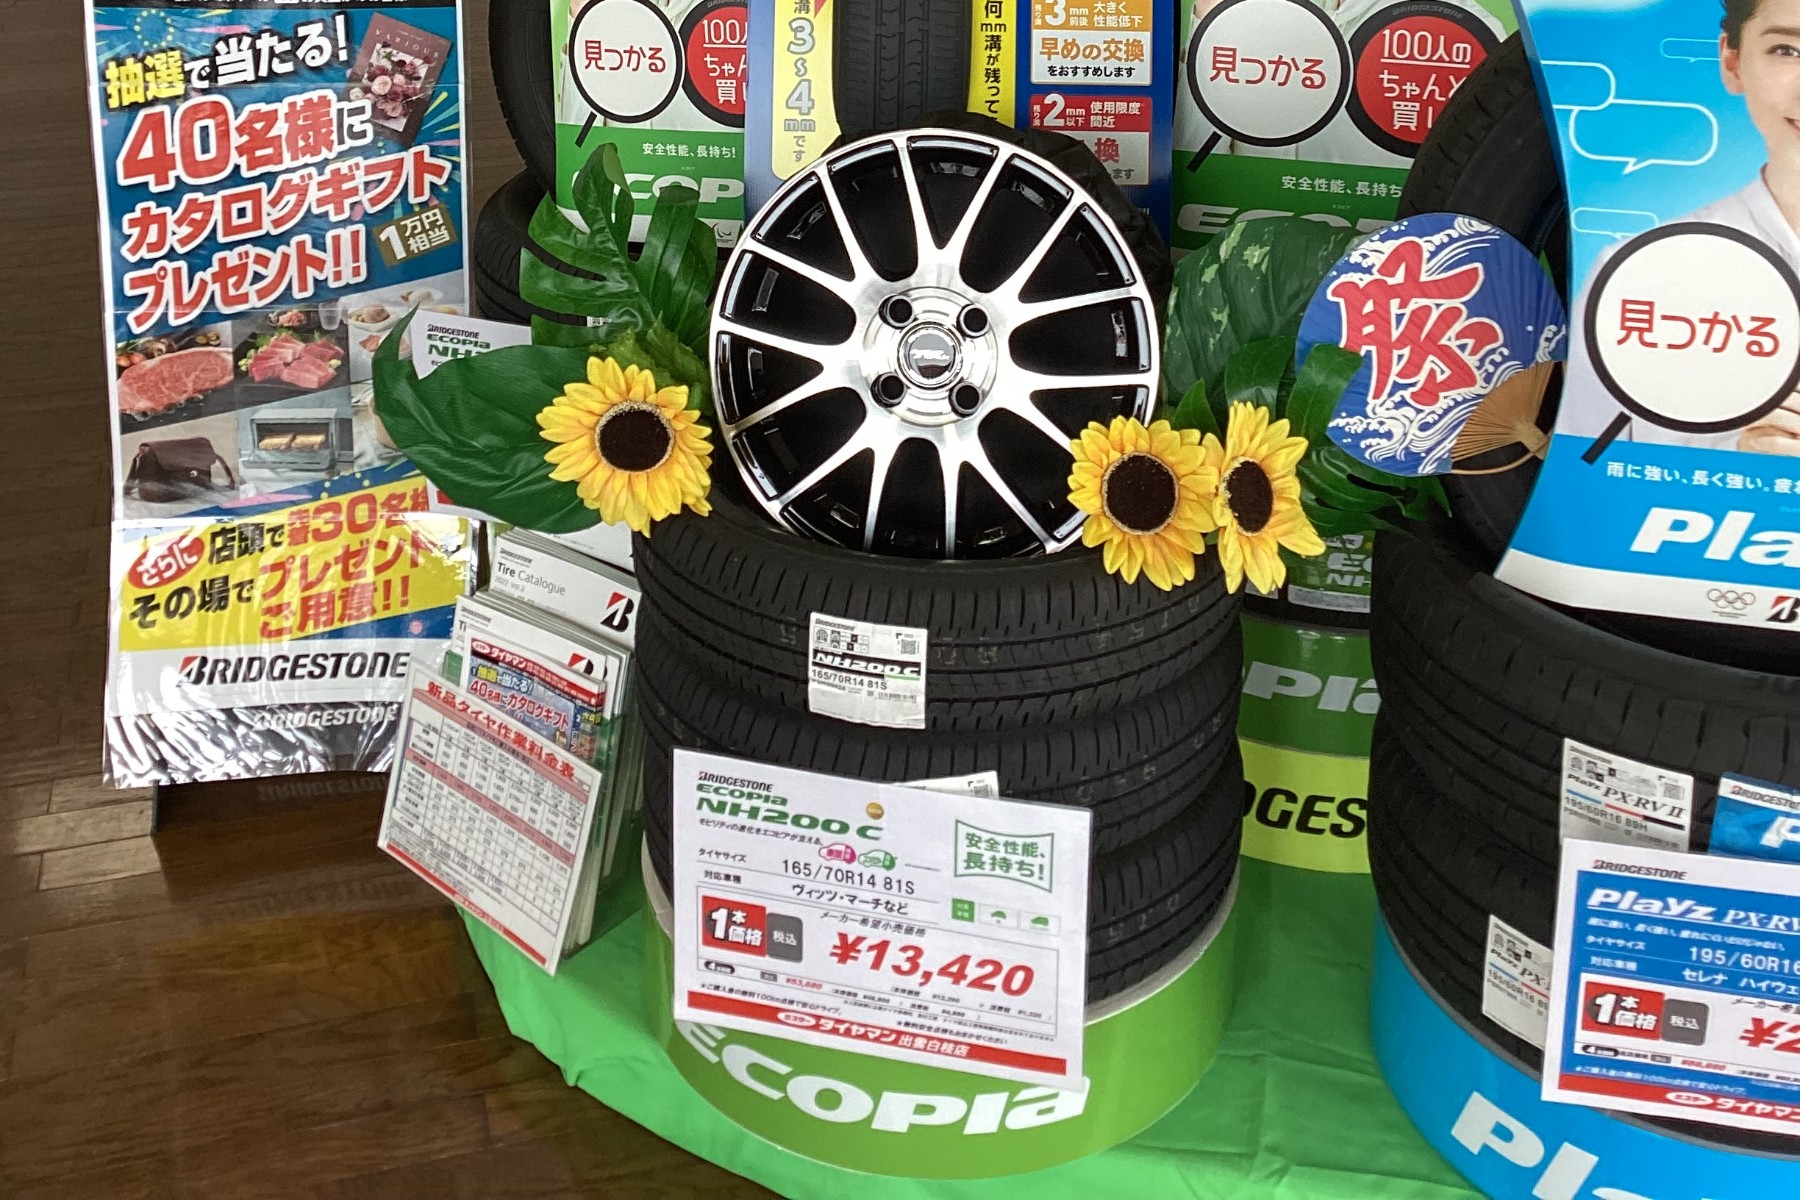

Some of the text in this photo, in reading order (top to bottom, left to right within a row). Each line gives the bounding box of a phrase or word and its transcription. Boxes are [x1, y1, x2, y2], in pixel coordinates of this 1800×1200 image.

[1069, 6, 1089, 16] mm
[1093, 1, 1128, 14] 大きく
[1069, 14, 1144, 28] 前後 性能低下
[583, 40, 667, 74] 見つかる
[1039, 36, 1146, 63] 早めの交換
[1382, 28, 1472, 63] 100人の
[1047, 65, 1136, 79] をおすすめします
[1209, 45, 1327, 90] 見つかる
[1043, 93, 1141, 127] 2 mm 使用限度
[1065, 115, 1116, 128] 以下 間近
[120, 94, 372, 188] 40名様に
[125, 150, 447, 259] カタログギフト
[408, 227, 451, 255] 相当
[1616, 298, 1780, 359] 見つかる
[208, 520, 285, 565] 店頭で
[139, 536, 204, 586] さらに
[497, 561, 567, 596] Tire Catalogue
[129, 575, 255, 630] その場で
[176, 650, 409, 688] BRIDGESTONE
[811, 668, 865, 688] 165/70R14
[866, 679, 888, 691] 81S
[426, 680, 576, 784] 新品タイヤ作業料金表
[698, 771, 773, 793] BRIDGESTONE
[1564, 796, 1623, 824] 195/60R16
[1602, 786, 1666, 814] PX-RV
[696, 797, 885, 841] NH200 C
[964, 831, 1046, 860] 安全性能、
[698, 847, 747, 864] タイヤサイズ
[782, 858, 877, 888] 165/70R14
[883, 878, 915, 896] 81S
[962, 854, 1045, 881] 長持ち!
[1592, 859, 1688, 881] BRIDGESTONE
[704, 869, 909, 916] 対応車種 ヴィッツ・マーチなど
[1587, 887, 1719, 921] Playz
[728, 925, 797, 947] 価格 税込
[819, 911, 927, 939] メーカー希望小売価格
[1586, 935, 1647, 951] タイヤサイズ
[829, 932, 1035, 997] ¥13,420
[1682, 967, 1729, 986] セレナ
[818, 1018, 897, 1043] タイヤマン
[898, 1034, 970, 1057] 出雲白枝店
[1615, 1011, 1701, 1030] 価格 税込
[1451, 1090, 1656, 1200] Pl
